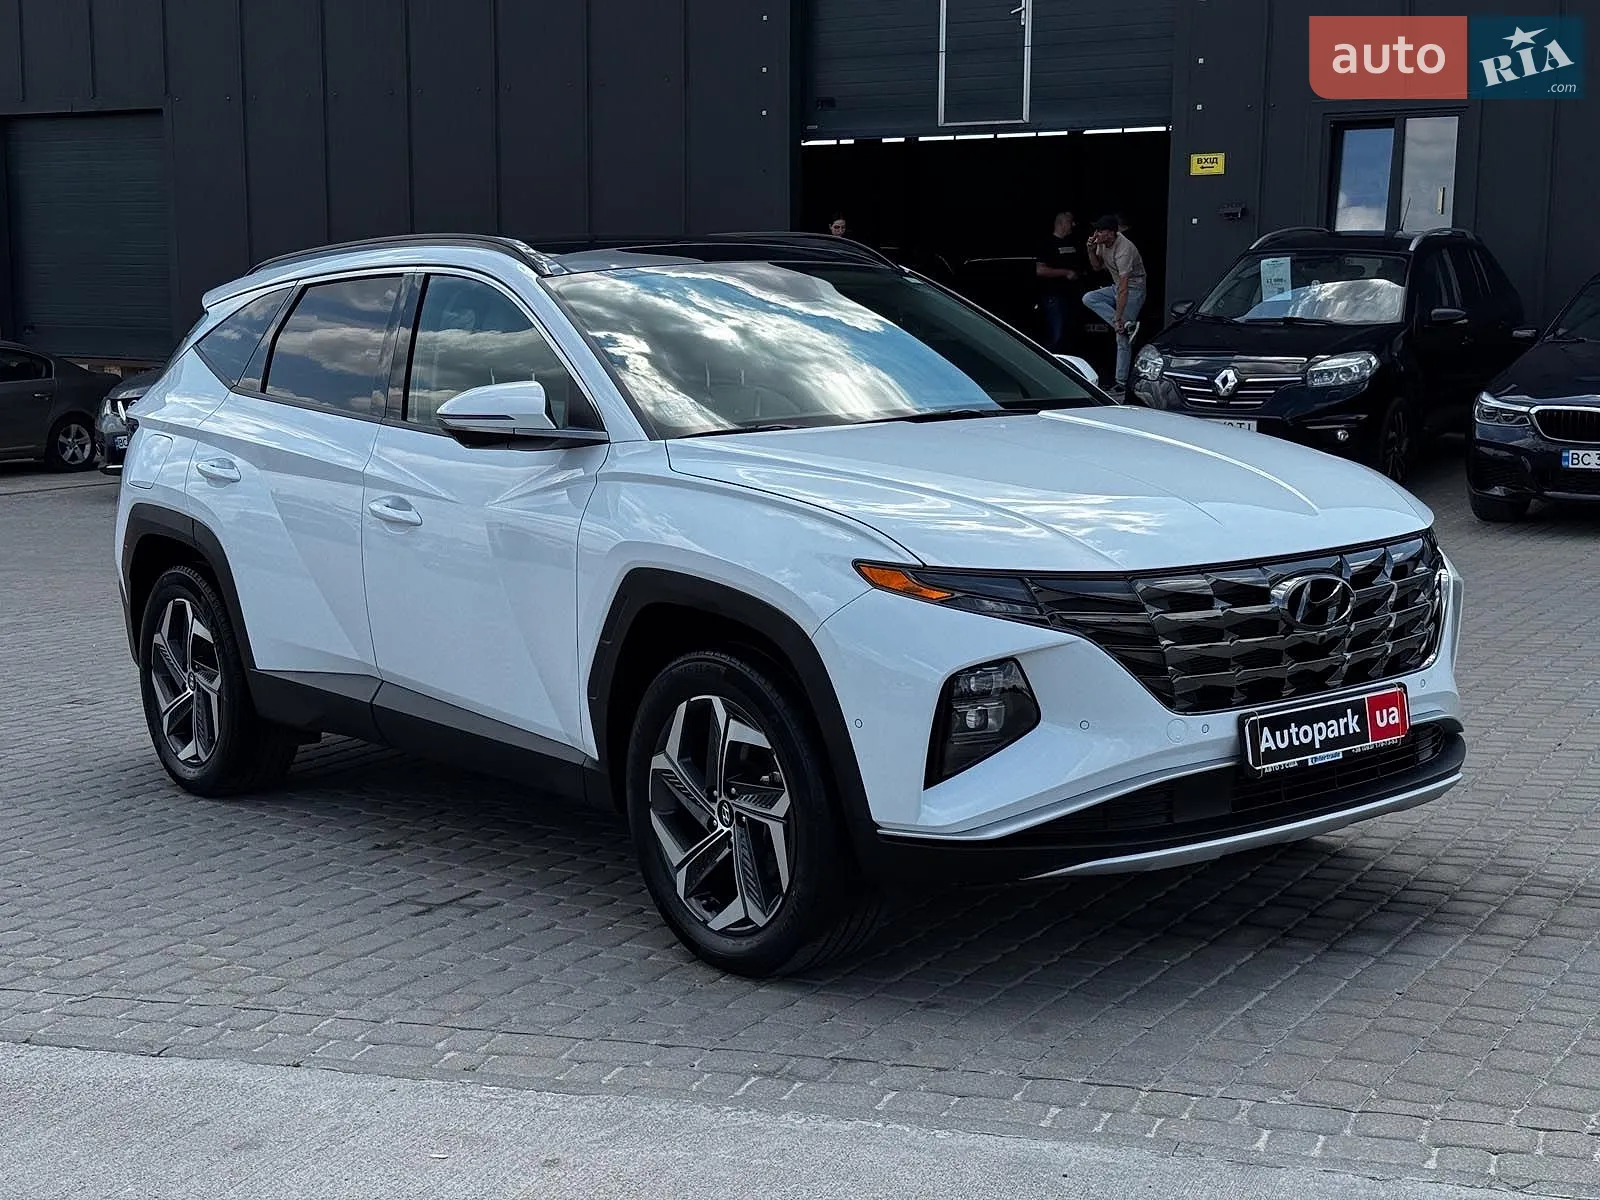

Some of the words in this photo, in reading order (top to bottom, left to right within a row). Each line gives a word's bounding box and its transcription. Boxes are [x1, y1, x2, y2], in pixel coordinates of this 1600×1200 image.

[1196, 157, 1218, 165] ВХІД
[1571, 452, 1591, 466] BC
[1376, 706, 1400, 728] ua
[1260, 709, 1360, 752] Autopark
